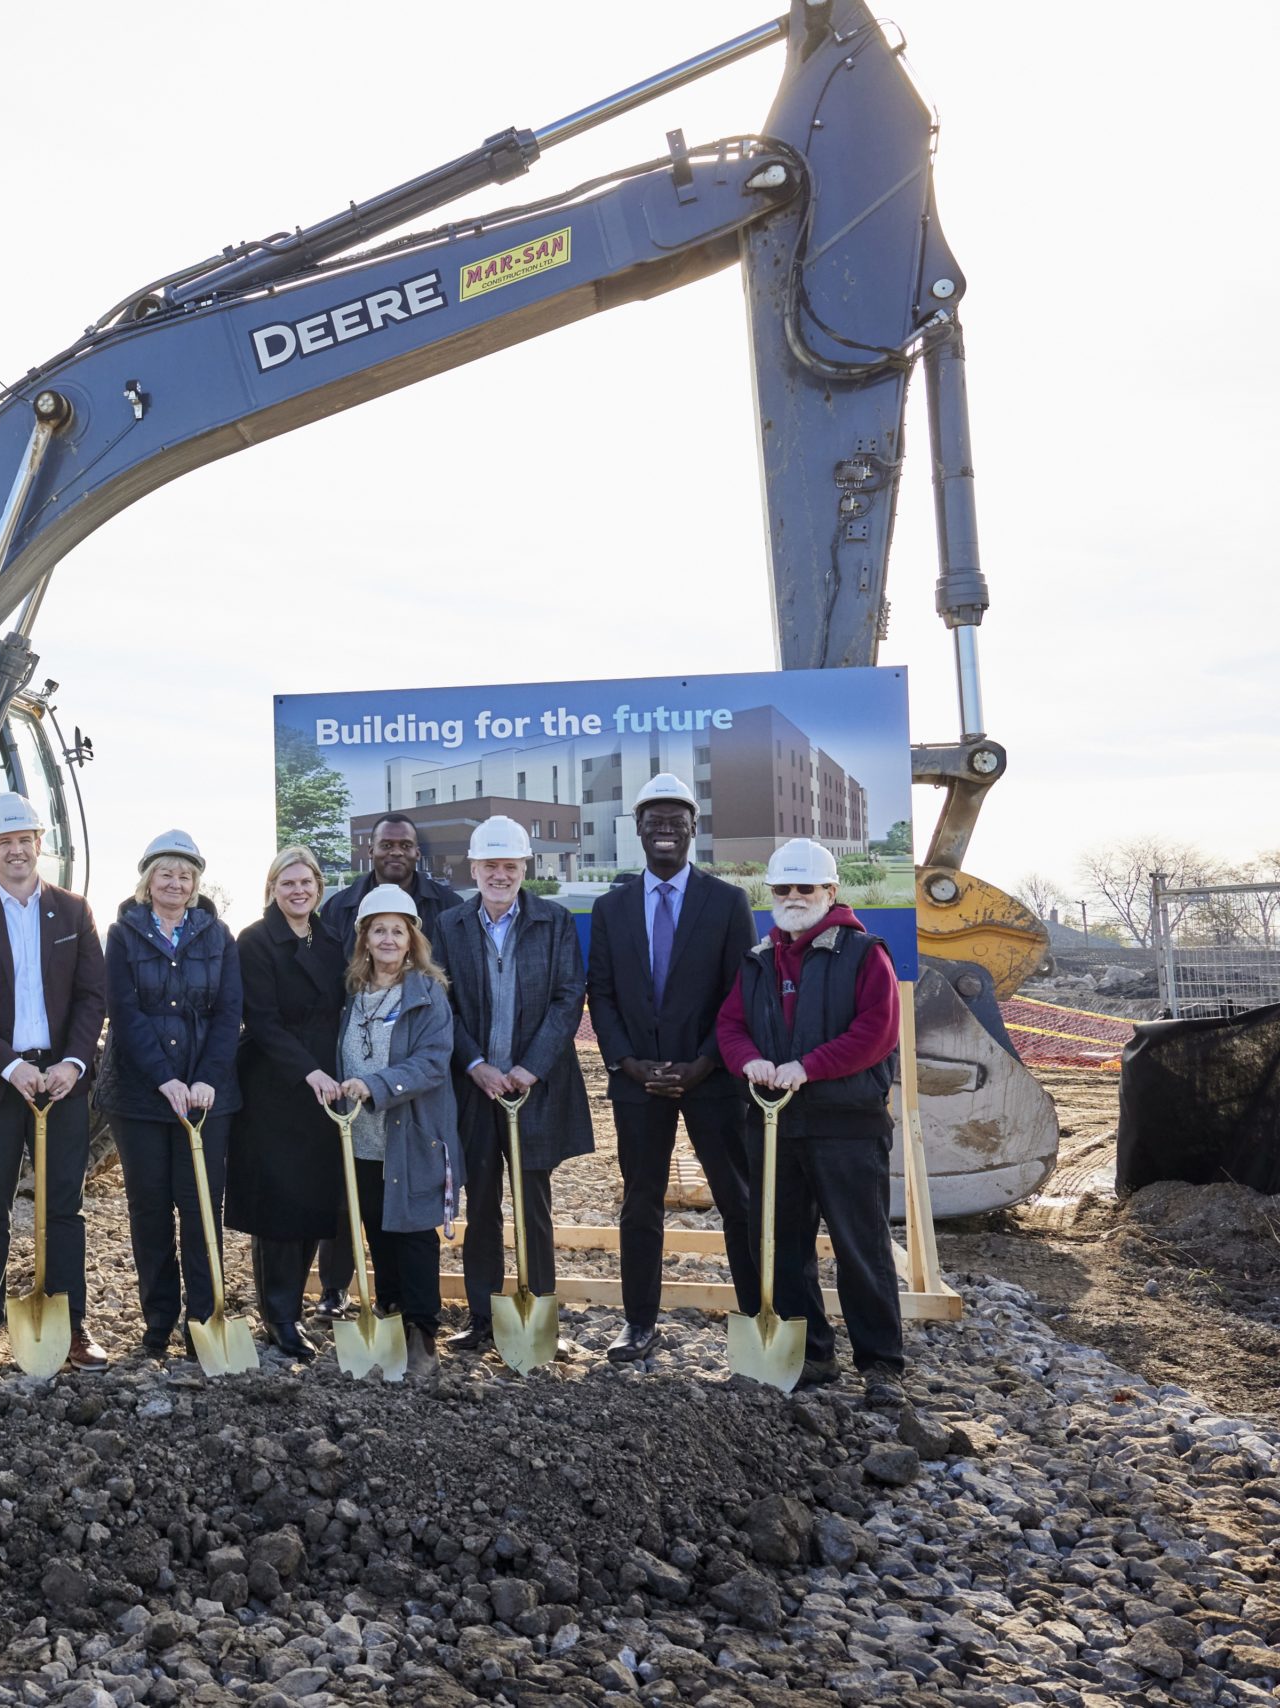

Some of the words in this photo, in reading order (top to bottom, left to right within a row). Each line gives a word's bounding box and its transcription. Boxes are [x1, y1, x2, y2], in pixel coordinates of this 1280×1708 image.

[466, 235, 564, 288] MAR-SAN
[481, 263, 538, 289] CONSTRUCTION
[253, 273, 443, 370] DEERE
[316, 713, 463, 748] Building
[474, 710, 531, 740] for
[540, 707, 602, 737] the
[613, 704, 733, 734] future
